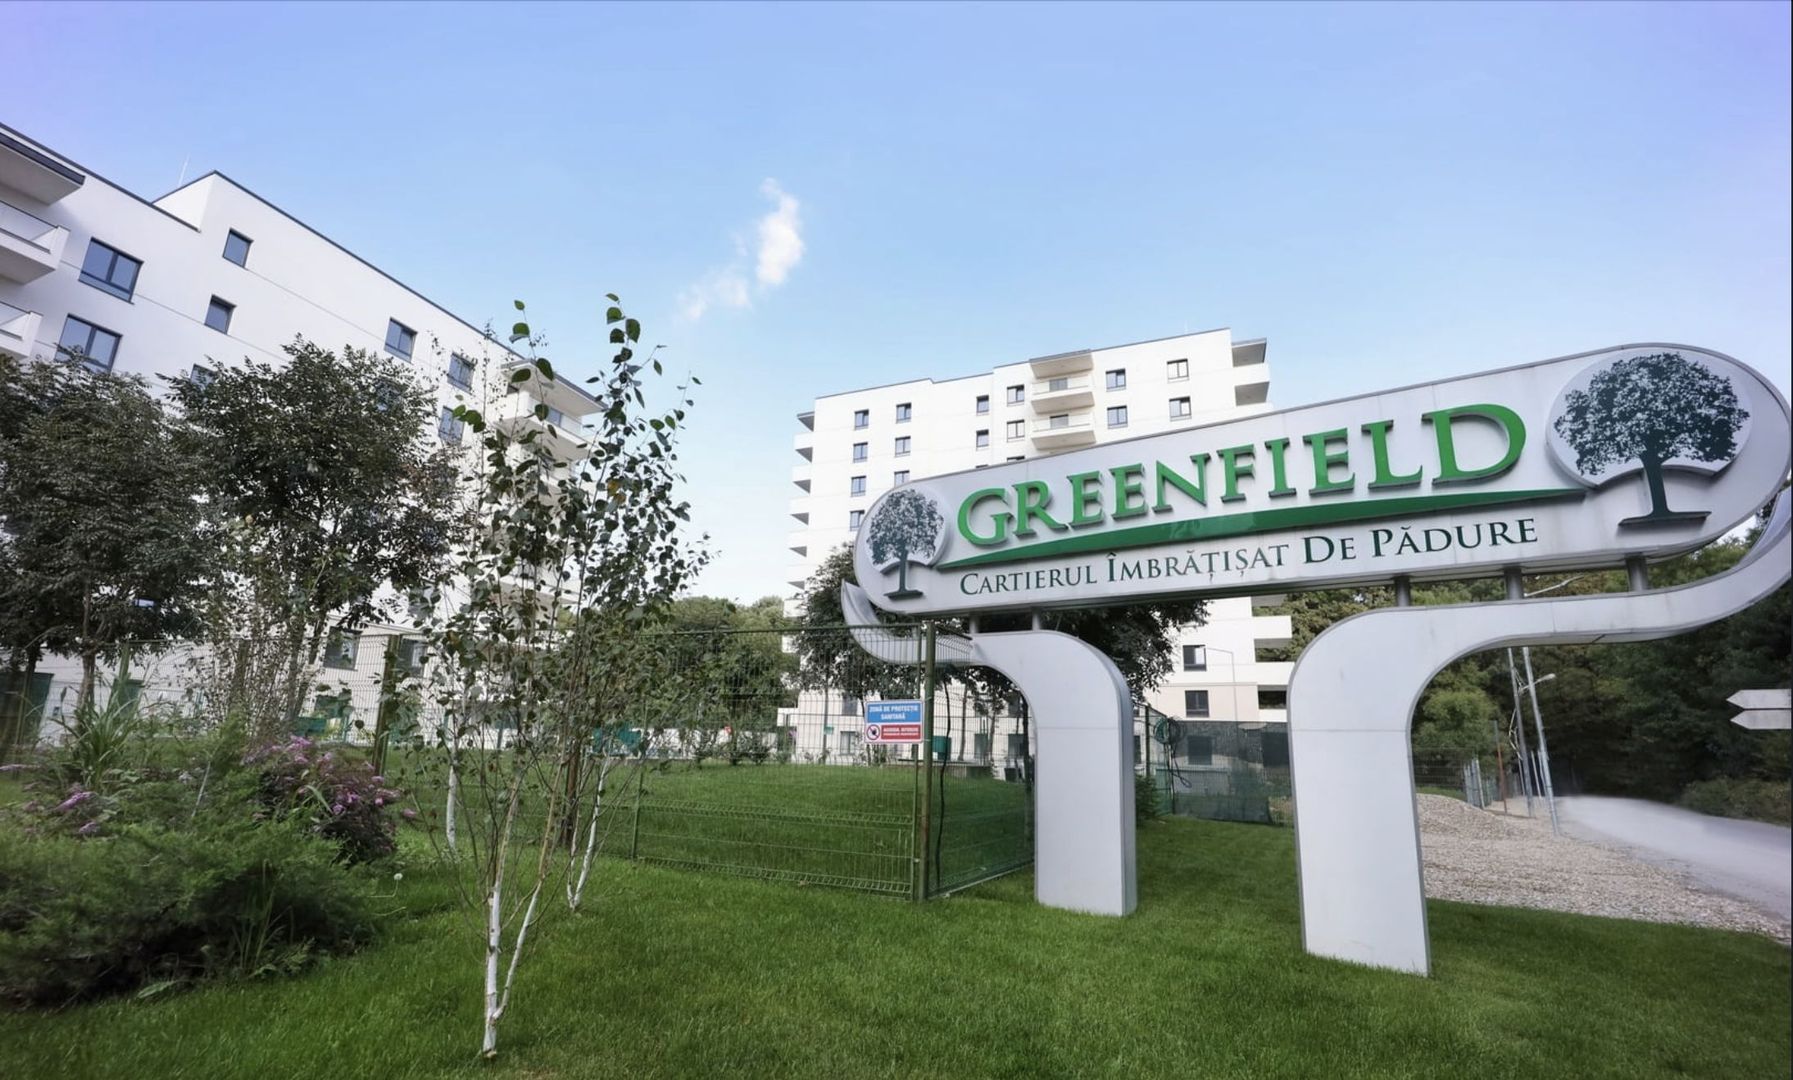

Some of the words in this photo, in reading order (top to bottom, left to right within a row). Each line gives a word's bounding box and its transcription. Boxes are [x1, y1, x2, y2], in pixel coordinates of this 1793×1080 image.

[957, 403, 1527, 546] GREENFIELD
[959, 564, 1098, 596] CARTIERUL
[1302, 535, 1357, 564] DE
[1371, 518, 1538, 558] PĂDURE
